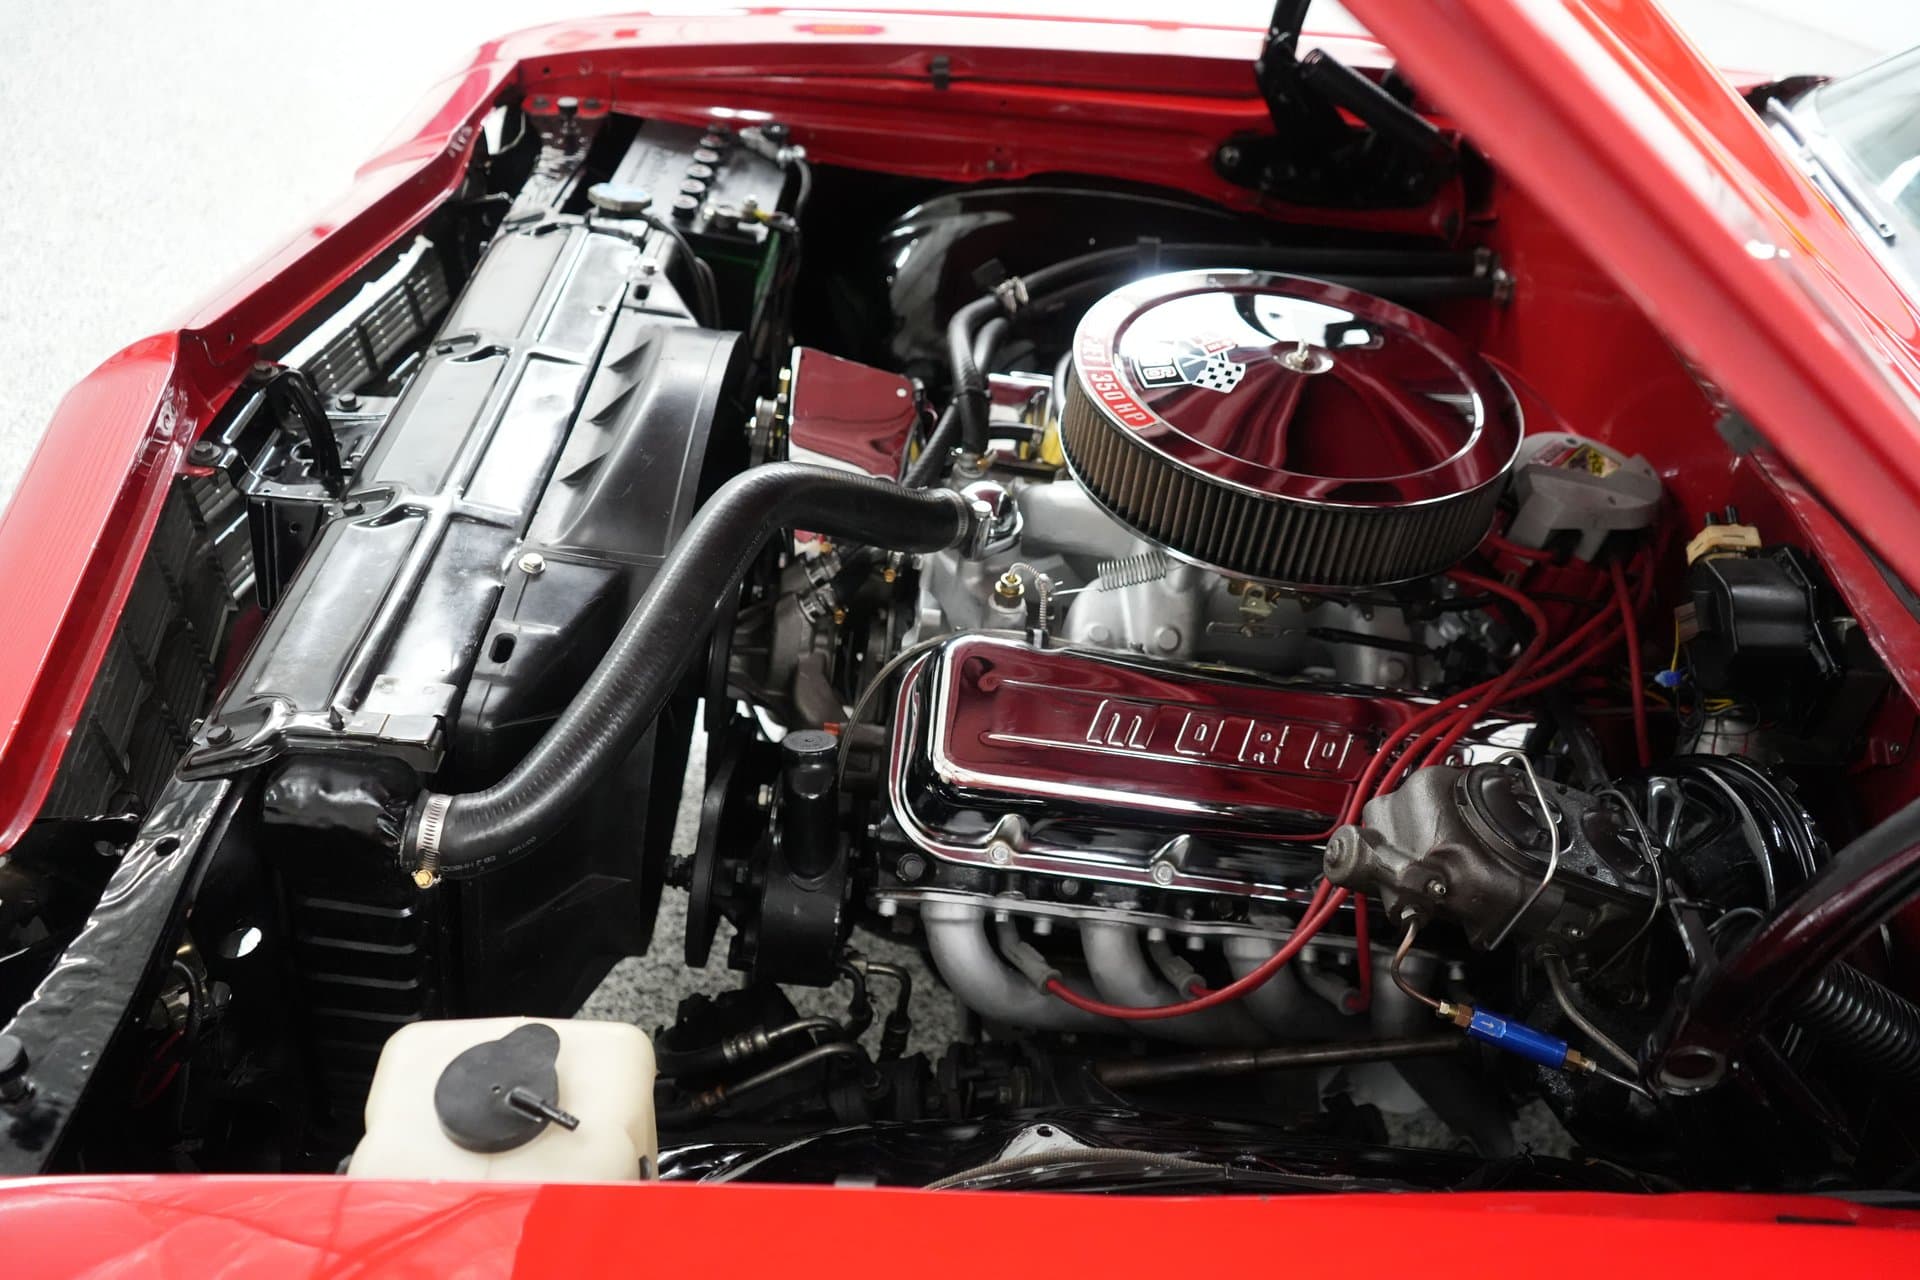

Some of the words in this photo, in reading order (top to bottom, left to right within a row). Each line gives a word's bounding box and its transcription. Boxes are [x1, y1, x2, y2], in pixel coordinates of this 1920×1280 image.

[1090, 373, 1126, 401] 350
[1113, 402, 1148, 421] HP
[1086, 699, 1404, 775] MORO
